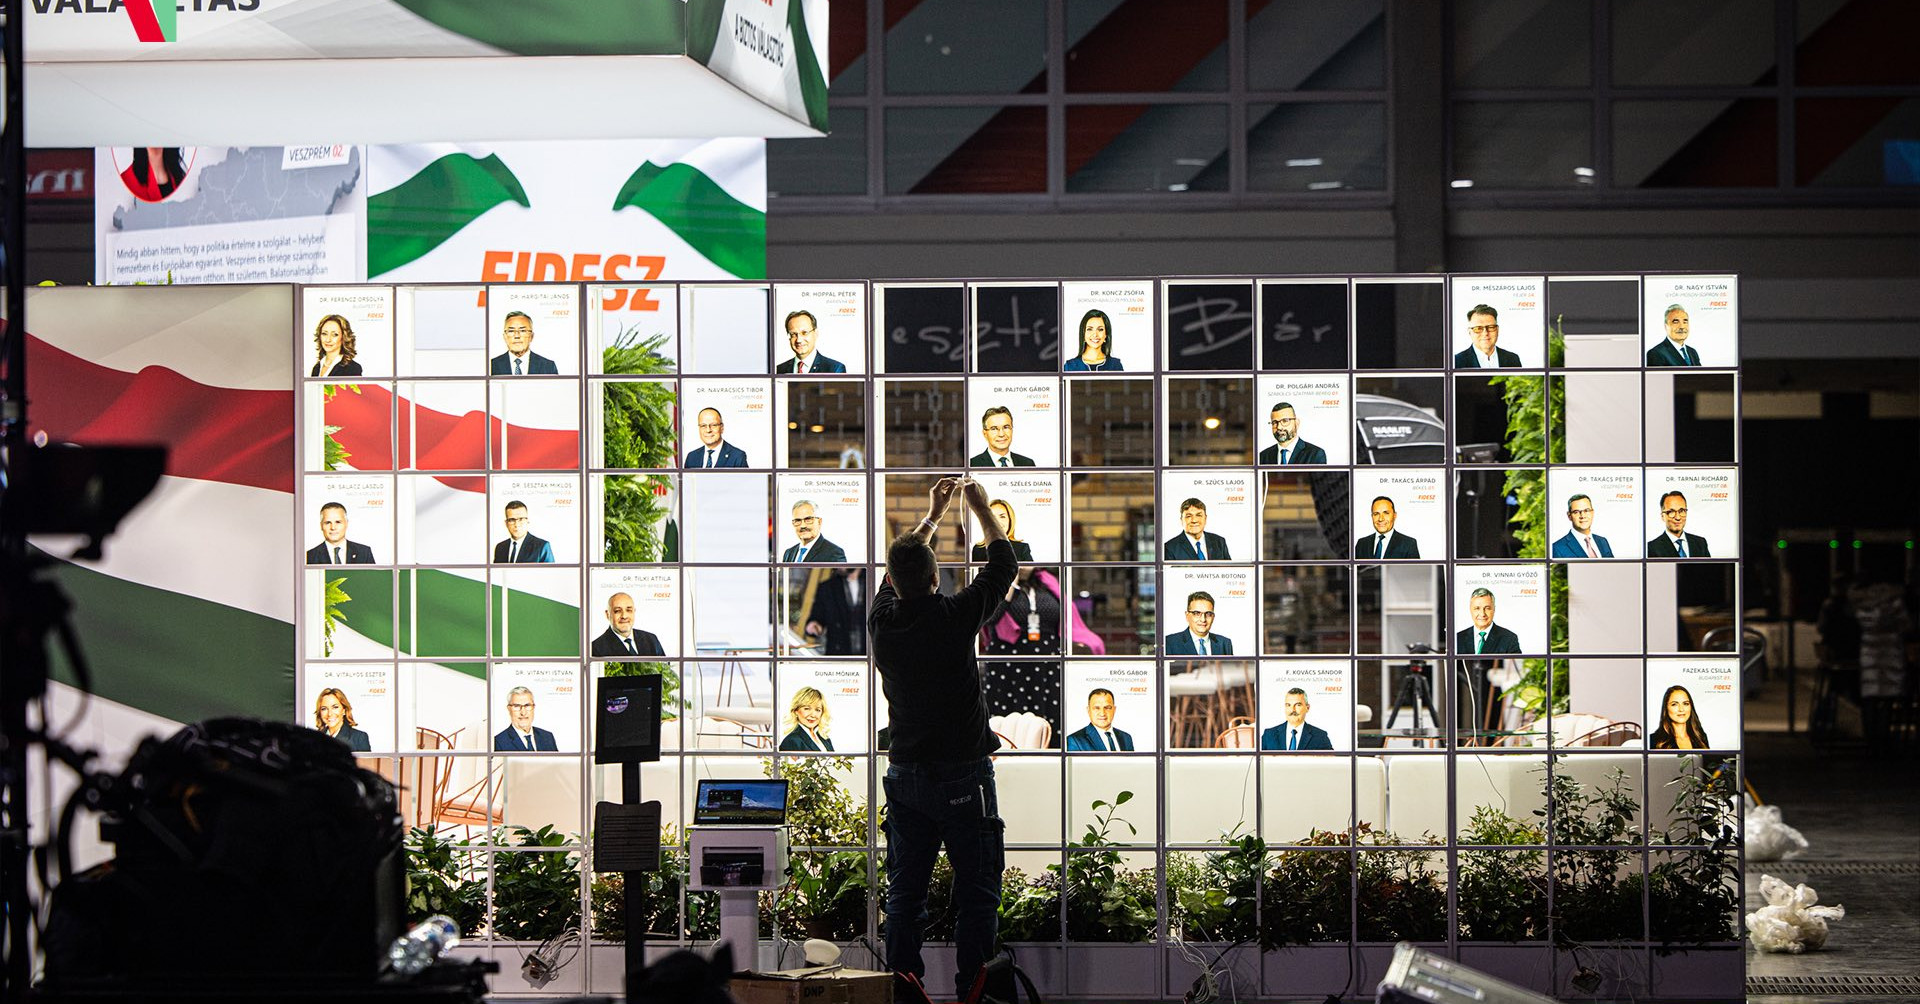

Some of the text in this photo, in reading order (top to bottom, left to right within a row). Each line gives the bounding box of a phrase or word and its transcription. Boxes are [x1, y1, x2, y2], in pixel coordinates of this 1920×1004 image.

[116, 248, 138, 260] Mindig
[140, 246, 159, 258] abban
[184, 244, 199, 256] hogy
[207, 240, 229, 254] politika
[117, 262, 151, 274] nemzetben
[153, 262, 159, 270] és
[477, 251, 666, 311] FIDESZ
[804, 986, 824, 997] DNP
